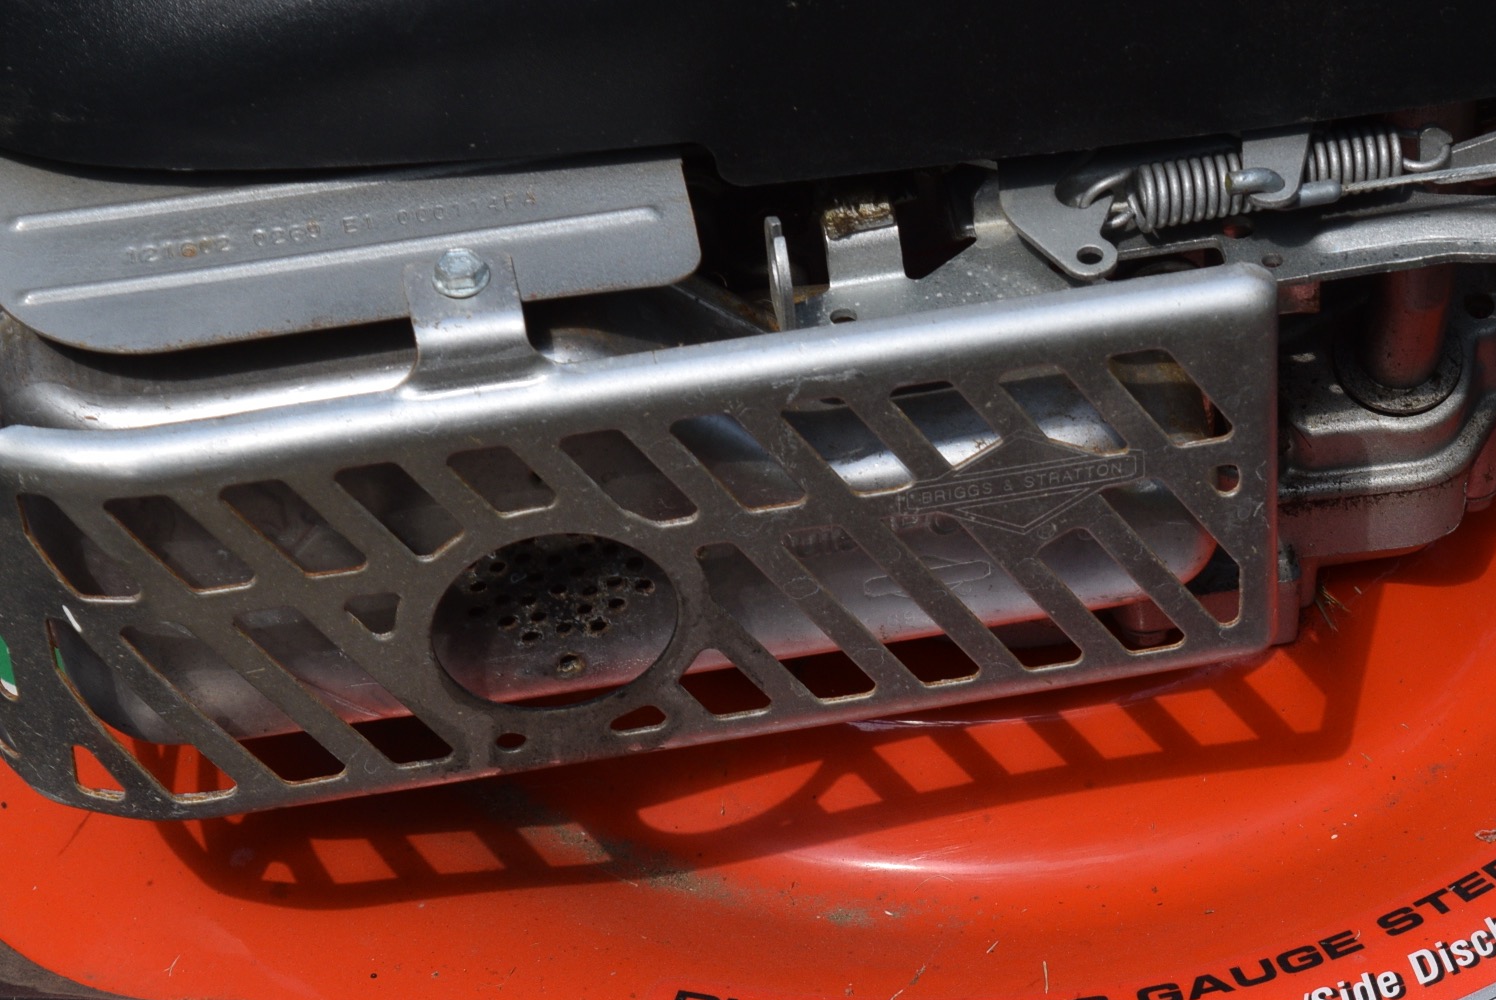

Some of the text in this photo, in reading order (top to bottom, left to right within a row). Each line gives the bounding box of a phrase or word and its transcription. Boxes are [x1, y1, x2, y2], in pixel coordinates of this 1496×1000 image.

[922, 463, 1123, 505] BRIGGS & STRATTON
